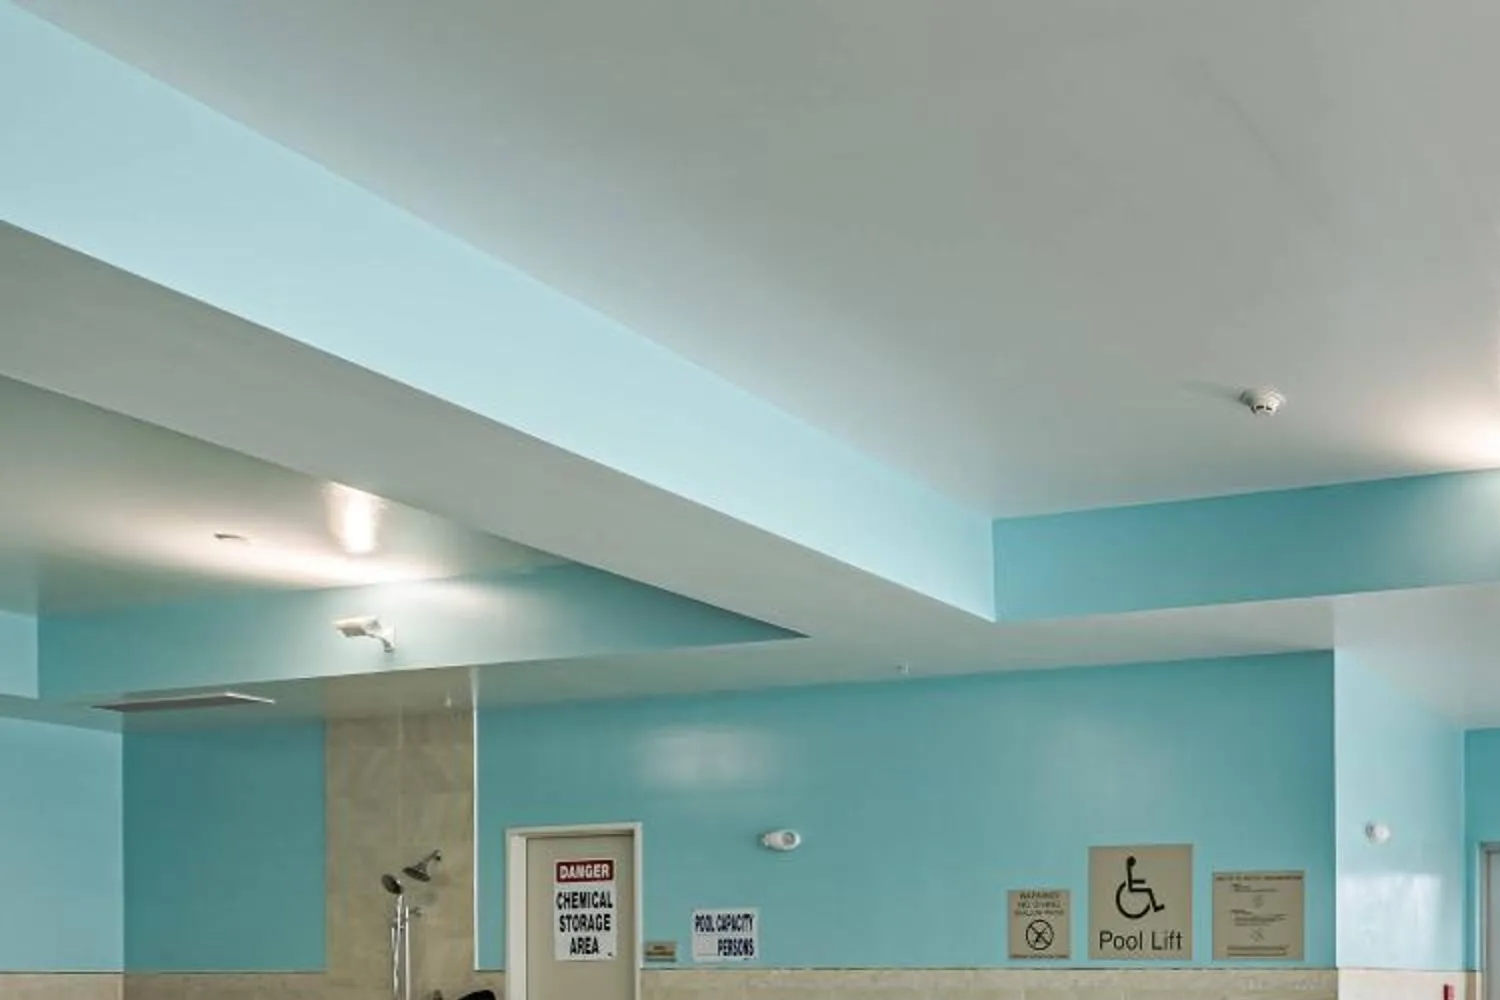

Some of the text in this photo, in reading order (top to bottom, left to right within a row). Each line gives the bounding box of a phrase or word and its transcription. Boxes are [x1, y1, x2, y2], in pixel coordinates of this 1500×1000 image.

[559, 863, 611, 881] DANGER
[556, 891, 613, 910] CHEMICAL
[559, 913, 611, 933] STORAGE
[695, 913, 754, 933] POOL CAPACITY
[569, 936, 600, 955] AREA
[717, 937, 754, 957] PERSONS
[1099, 930, 1183, 951] Pool Lift
